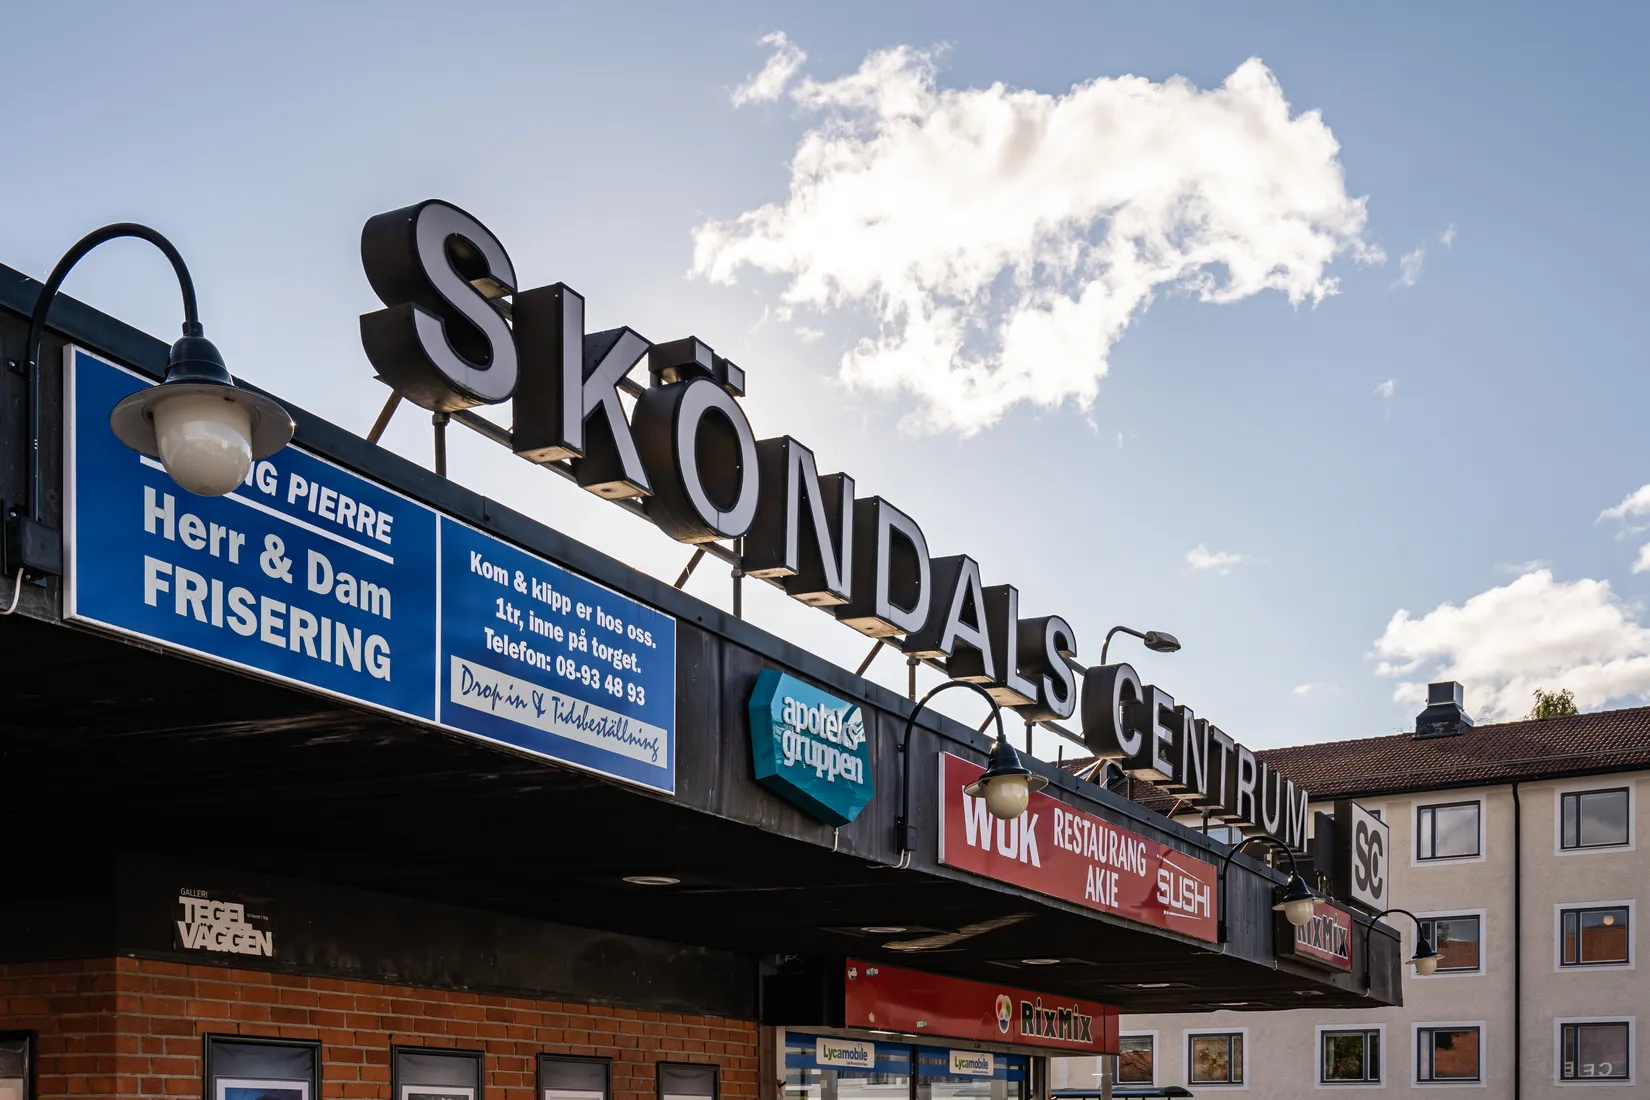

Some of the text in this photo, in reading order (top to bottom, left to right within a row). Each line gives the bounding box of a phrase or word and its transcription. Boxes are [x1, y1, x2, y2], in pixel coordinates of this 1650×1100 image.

[287, 472, 394, 545] PIERRE
[412, 200, 1309, 854] SKÖNDALS CENTRUM
[143, 485, 392, 620] Herr & Dam
[143, 554, 391, 682] FRISERING
[470, 550, 657, 649] Kom & klipp er hos oss.
[484, 626, 646, 706] Telefon: 08-93 48 93
[495, 597, 642, 674] 1tr, inne på torget.
[551, 695, 660, 763] Tidsbeställning
[781, 696, 859, 751] apoteks
[781, 729, 864, 785] gruppen
[961, 785, 1042, 869] WOK
[1053, 807, 1147, 877] RESTAURANG
[1354, 819, 1383, 900] SC
[178, 895, 253, 931] TEGEL
[180, 887, 208, 899] GALLERI
[1085, 864, 1119, 909] AKIE
[1156, 867, 1211, 919] SUSHI
[177, 920, 273, 957] VÄGGEN
[823, 1043, 868, 1062] Lycamobile
[1020, 997, 1094, 1044] RixMix
[954, 1054, 989, 1070] Lycamobile
